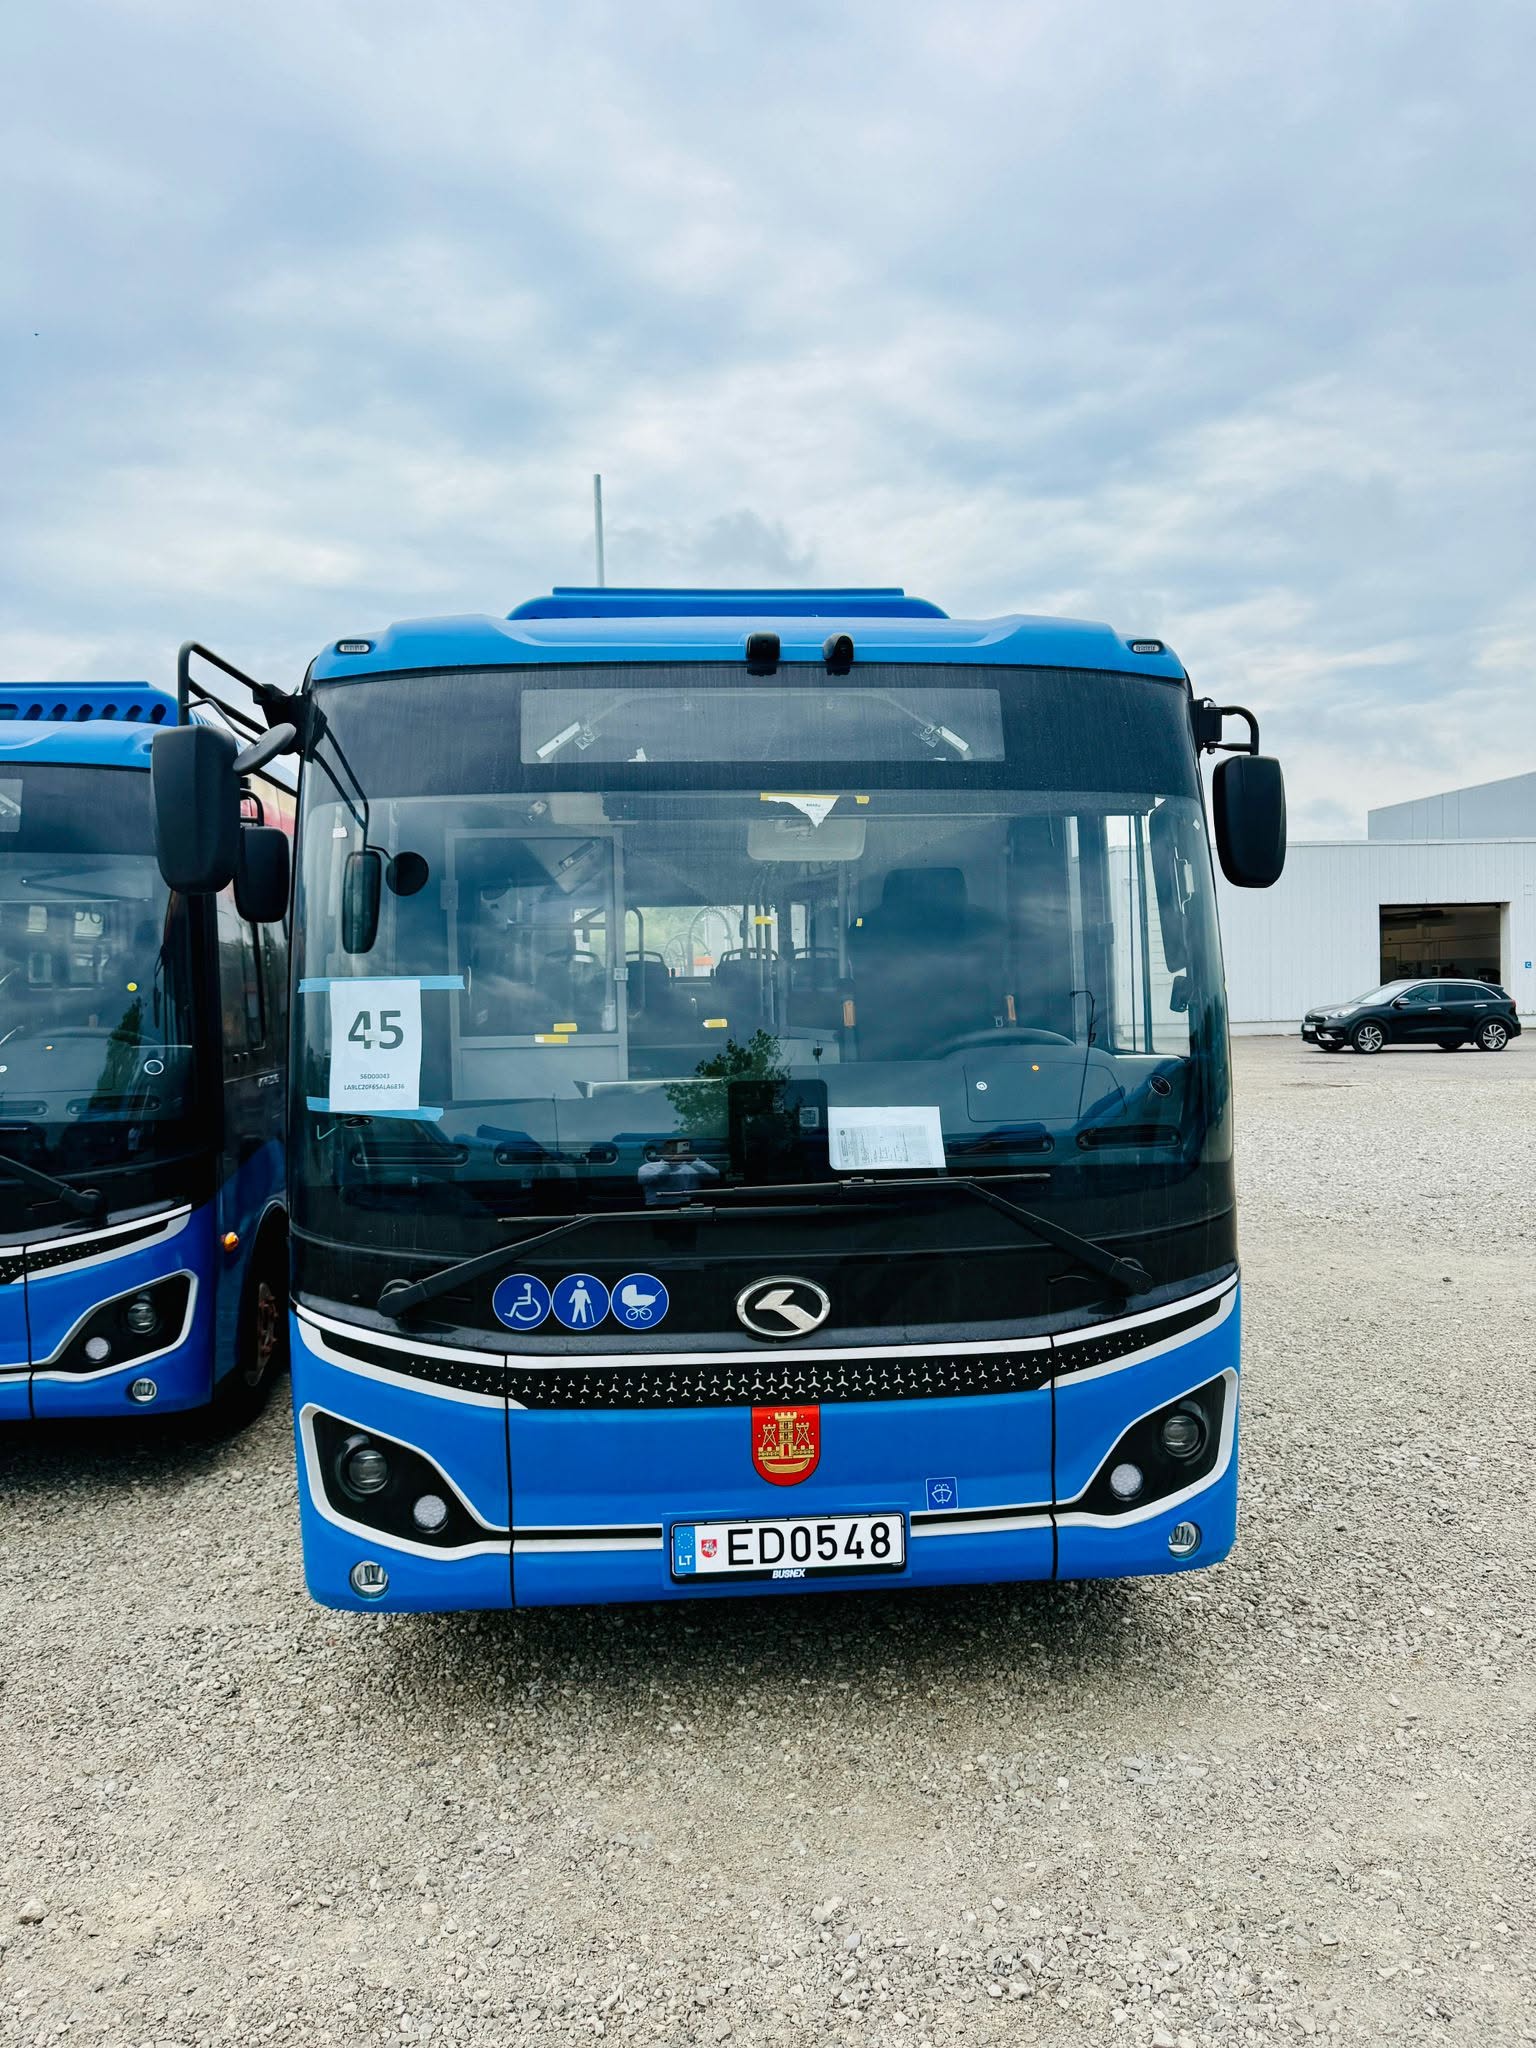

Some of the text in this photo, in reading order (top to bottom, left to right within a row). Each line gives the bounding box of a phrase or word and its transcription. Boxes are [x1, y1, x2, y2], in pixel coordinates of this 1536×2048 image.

[348, 1010, 404, 1050] 45
[727, 1521, 891, 1566] ED0548
[678, 1555, 693, 1567] LT
[772, 1568, 805, 1579] BUSNEX
